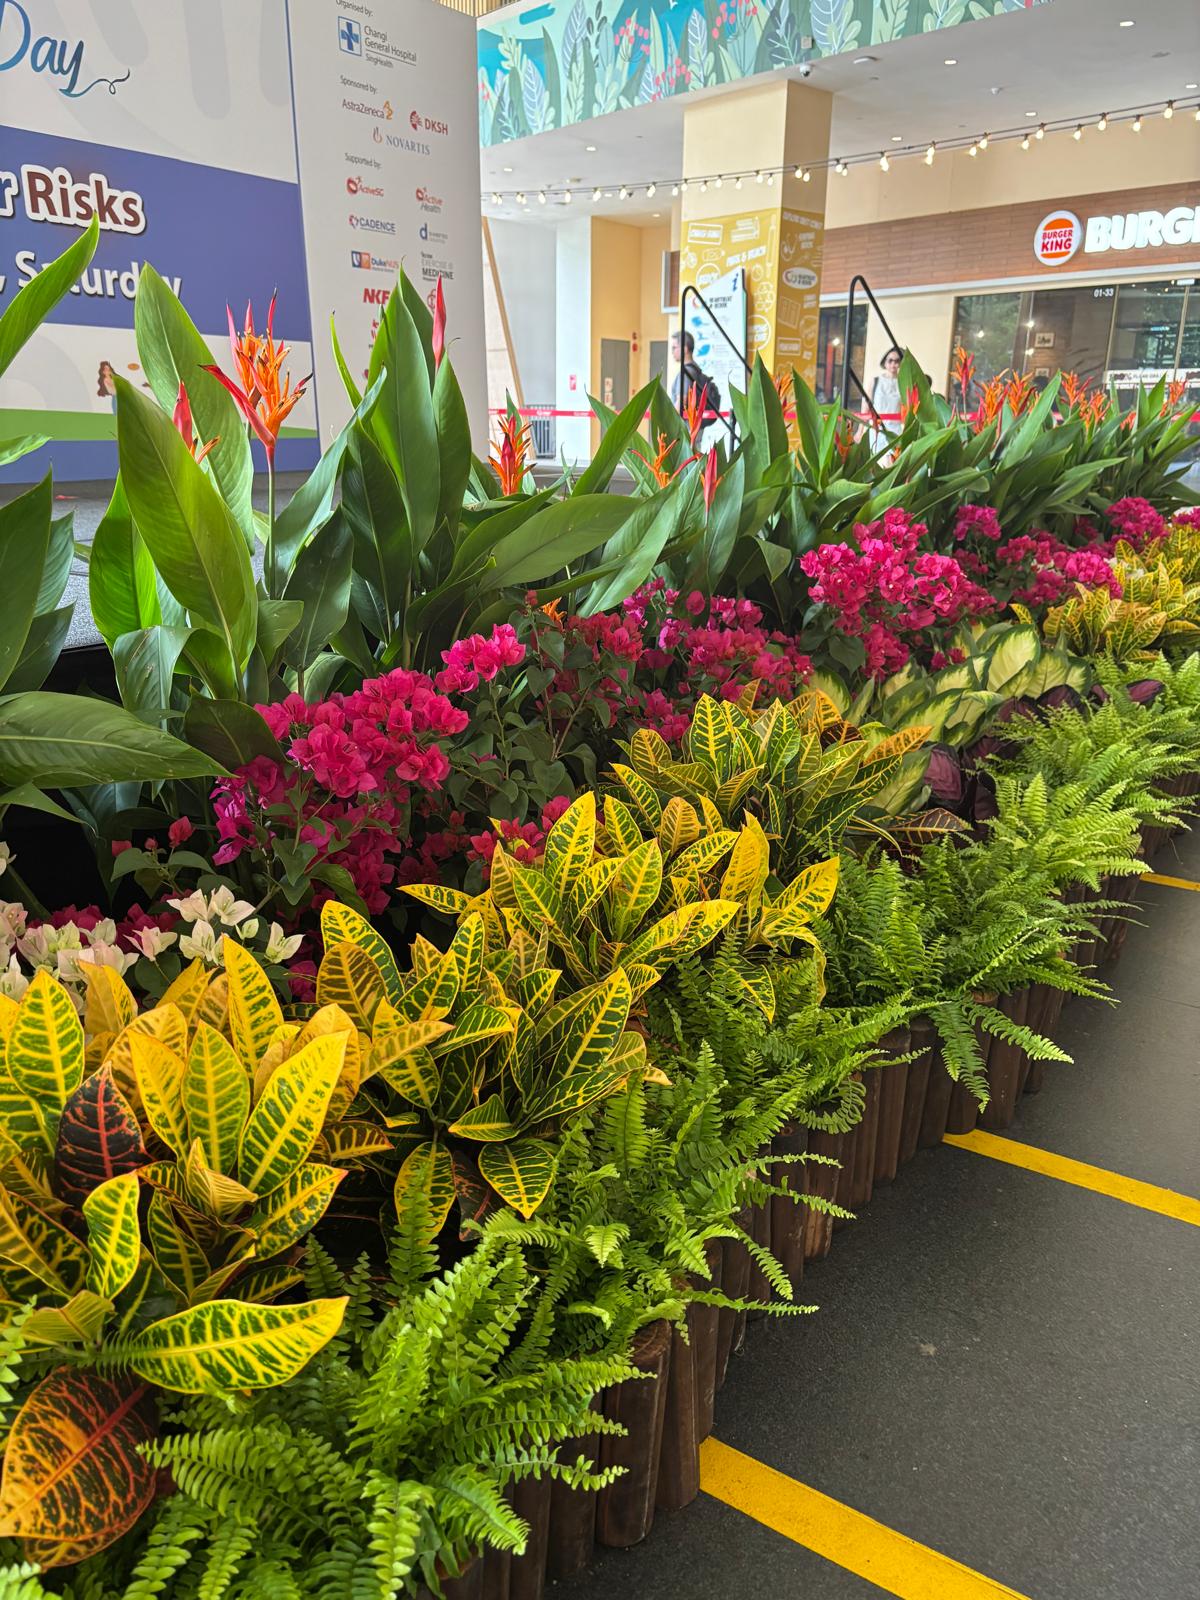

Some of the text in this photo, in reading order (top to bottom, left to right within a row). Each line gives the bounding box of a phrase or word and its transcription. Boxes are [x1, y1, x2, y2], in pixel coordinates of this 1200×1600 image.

[364, 25, 388, 42] Changi
[364, 37, 417, 61] General Hospital
[340, 75, 368, 91] Sponsored
[342, 99, 384, 119] AstraZeneca
[424, 118, 449, 136] DKSH
[386, 134, 431, 155] NOVARTIS
[345, 152, 373, 167] Supported
[27, 171, 141, 227] Risks
[359, 217, 396, 233] CADENCE
[1042, 229, 1073, 240] BURGER
[1041, 238, 1072, 252] KING
[1093, 287, 1114, 298] 01-33
